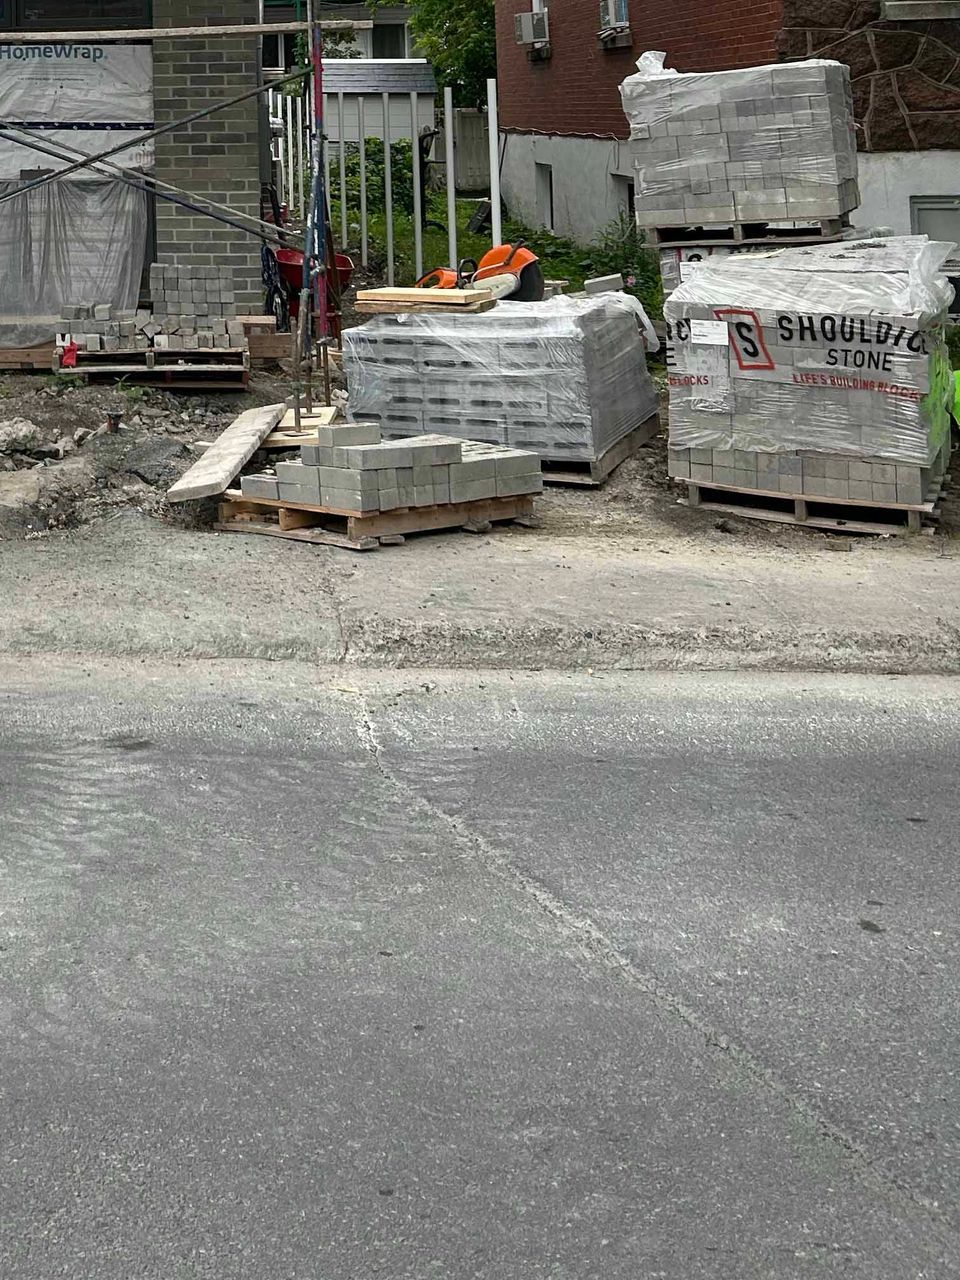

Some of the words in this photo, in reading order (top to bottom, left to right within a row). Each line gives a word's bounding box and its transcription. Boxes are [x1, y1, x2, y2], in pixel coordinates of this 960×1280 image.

[735, 321, 759, 358] S
[826, 348, 895, 372] STONE
[830, 375, 876, 391] BUILDING
